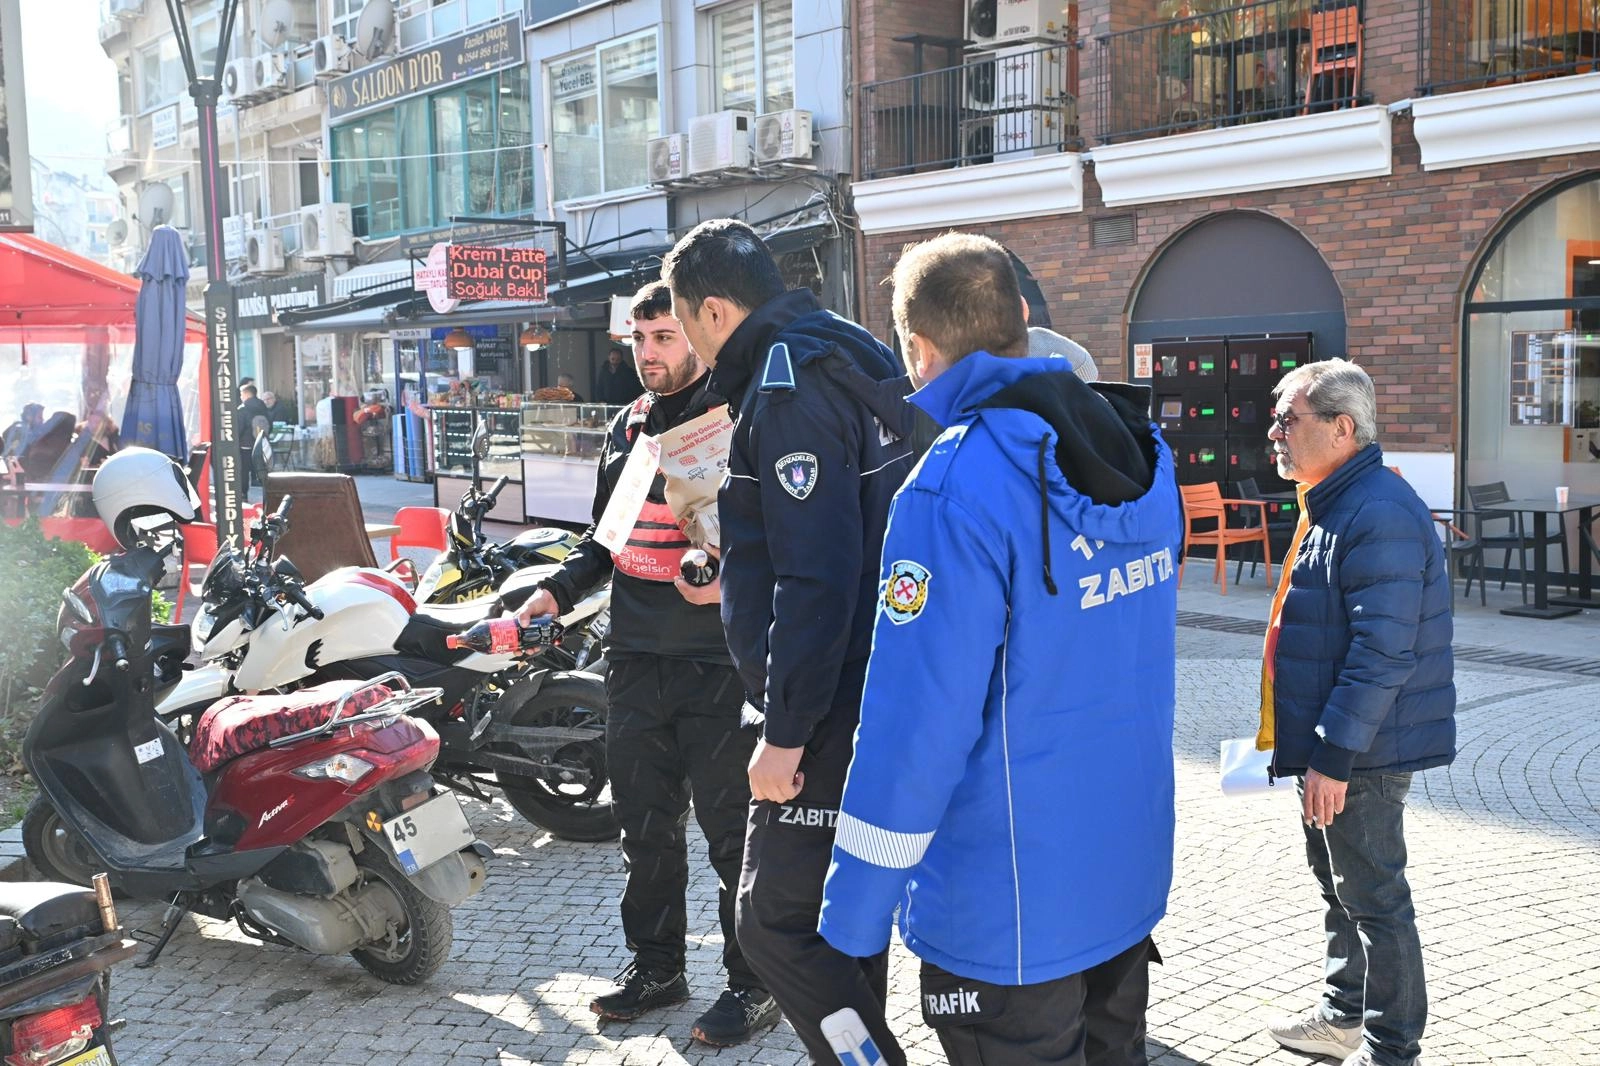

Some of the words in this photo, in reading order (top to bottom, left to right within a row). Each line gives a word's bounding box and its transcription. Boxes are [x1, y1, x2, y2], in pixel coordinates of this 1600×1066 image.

[352, 61, 405, 107] SALOON
[408, 50, 443, 90] D'OR
[580, 72, 594, 86] BEL
[451, 245, 496, 262] Krem
[502, 248, 545, 263] Latte
[453, 263, 504, 279] Dubai
[508, 265, 542, 283] Cup
[455, 282, 502, 299] Soğuk
[1154, 362, 1162, 371] A
[1188, 361, 1197, 371] B
[1231, 359, 1238, 369] A
[1189, 407, 1197, 417] C
[1232, 407, 1239, 417] C
[667, 443, 696, 457] Kazana
[694, 428, 721, 446] Kazana
[1079, 547, 1174, 610] ZABITA
[393, 815, 418, 841] 45
